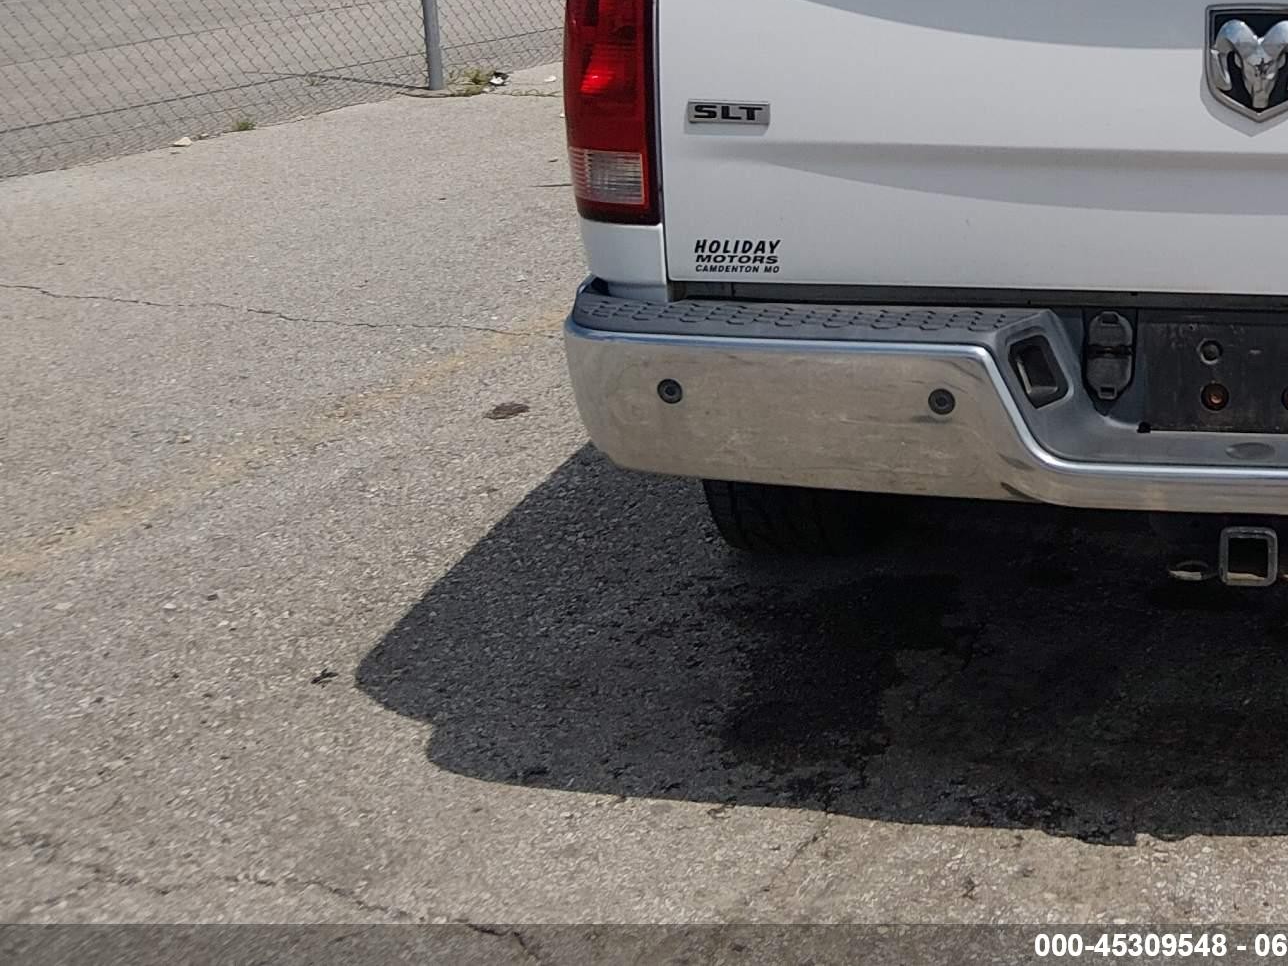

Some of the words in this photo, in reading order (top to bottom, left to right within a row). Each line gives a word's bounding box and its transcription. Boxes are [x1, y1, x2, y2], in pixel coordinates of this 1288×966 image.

[694, 104, 763, 121] SLT
[694, 239, 781, 254] HOLIDAY
[695, 254, 779, 264] MOTORS
[695, 264, 759, 273] CAMDENTON
[764, 265, 780, 273] MO
